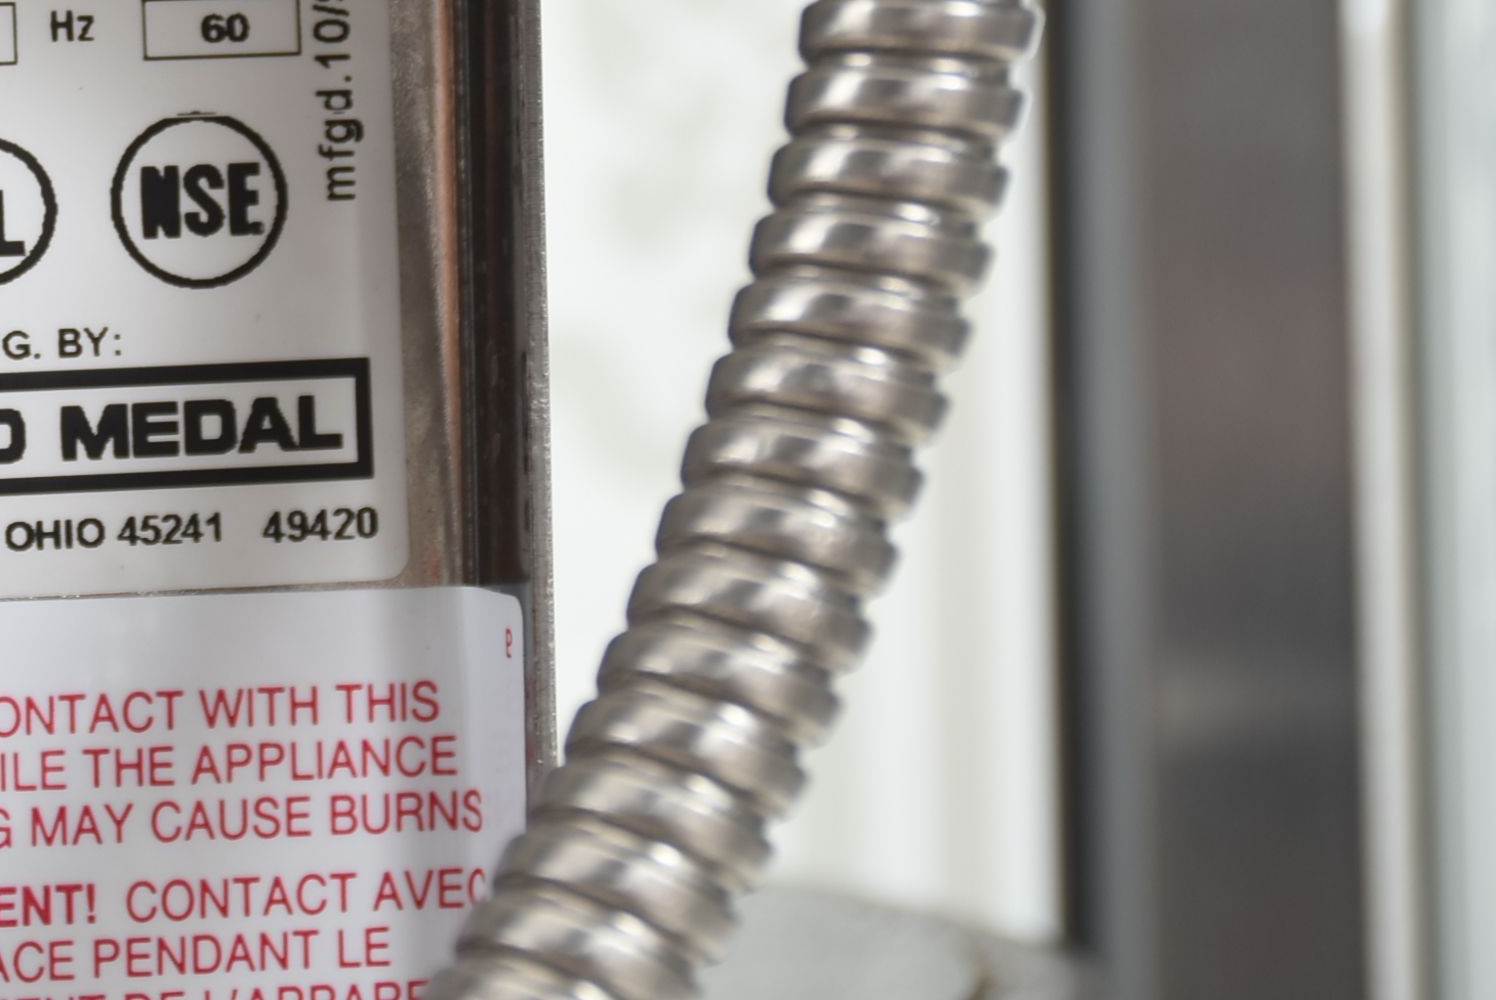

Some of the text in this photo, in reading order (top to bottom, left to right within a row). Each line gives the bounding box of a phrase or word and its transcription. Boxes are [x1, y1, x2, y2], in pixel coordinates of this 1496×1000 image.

[49, 9, 96, 43] Hz
[200, 12, 251, 44] 60
[57, 326, 123, 360] BY:
[59, 394, 344, 464] MEDAL
[4, 517, 108, 553] OHIO
[115, 511, 223, 548] 45241
[261, 506, 379, 545] 49420
[199, 684, 321, 729] WITH
[336, 679, 441, 724] THIS
[83, 744, 176, 788] THE
[191, 734, 458, 786] APPLIANCE
[30, 802, 135, 847] MAY
[151, 794, 314, 844] CAUSE
[329, 788, 485, 837] BURNS
[125, 871, 359, 924] CONTACT
[93, 927, 321, 978] PENDANT
[337, 924, 393, 970] LE
